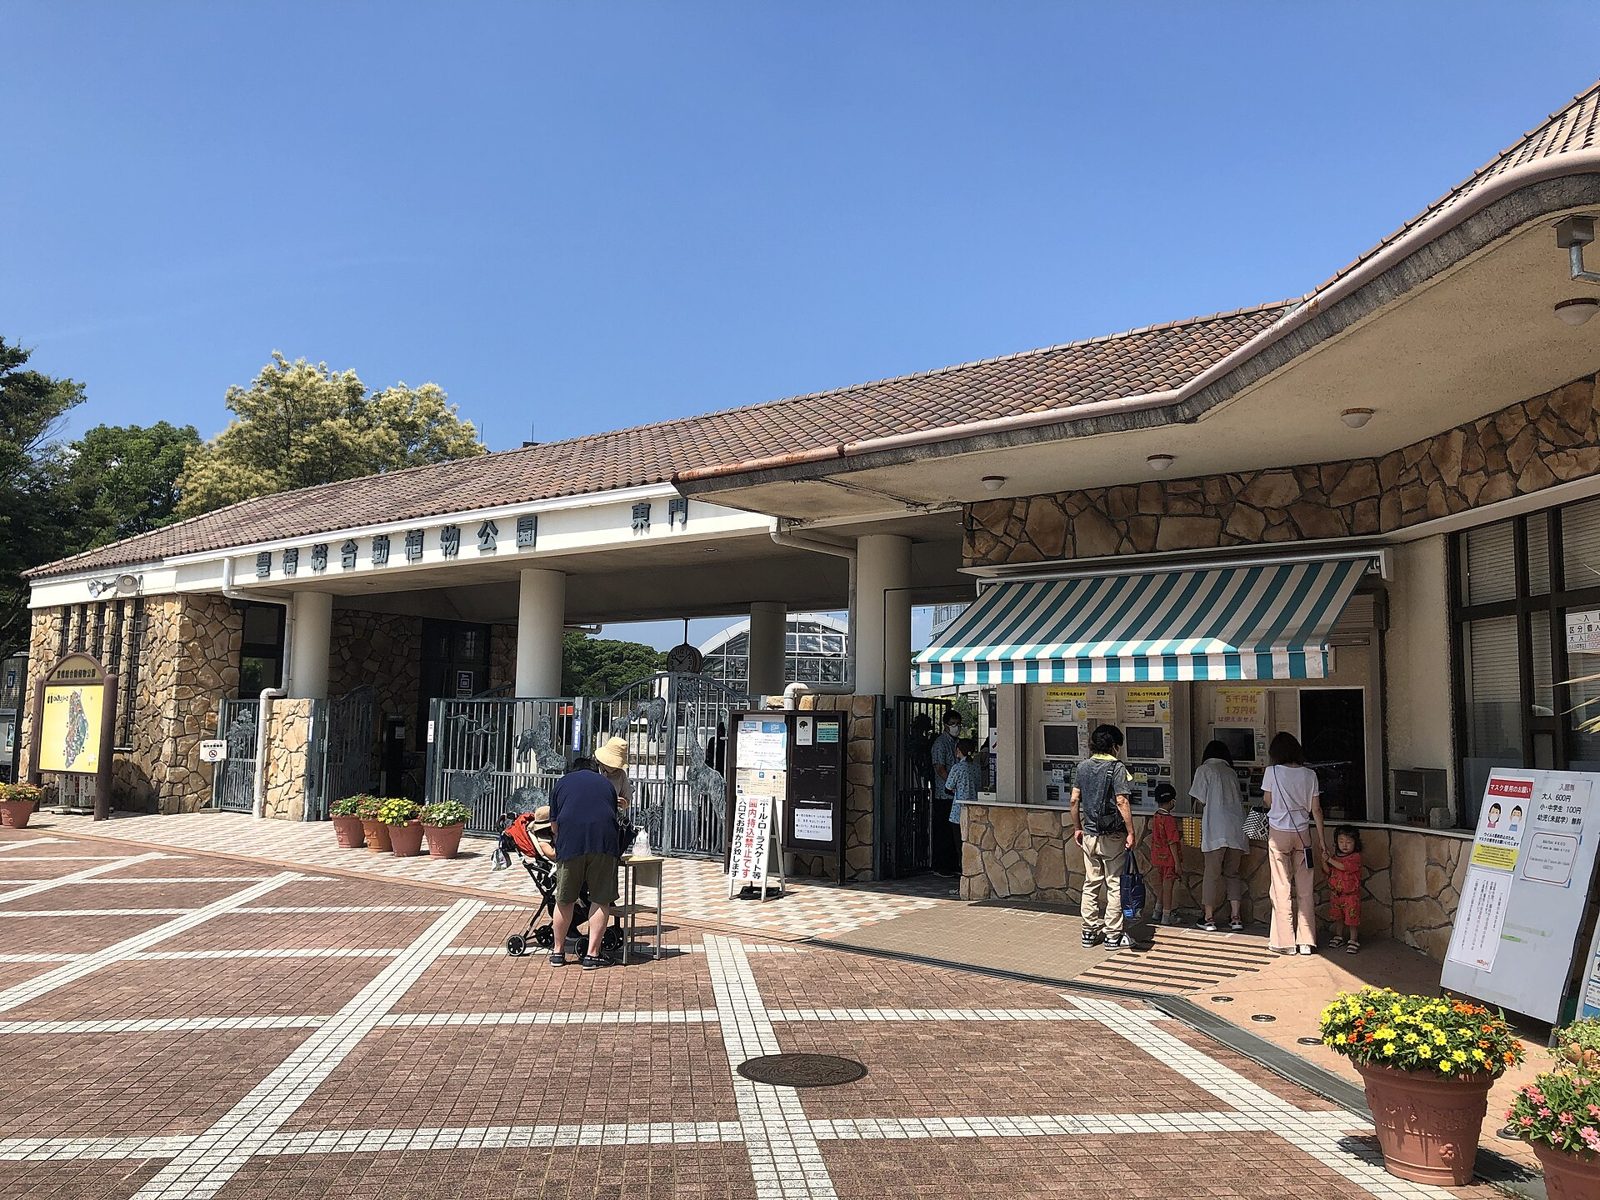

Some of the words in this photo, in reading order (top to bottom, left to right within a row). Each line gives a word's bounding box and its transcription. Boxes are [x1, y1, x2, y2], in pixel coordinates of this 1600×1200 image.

[631, 498, 688, 529] 東門
[256, 515, 538, 577] 豊橋総合動植物公園
[1225, 695, 1257, 703] 5千円札
[1540, 804, 1563, 812] 小・中学生
[1566, 806, 1582, 814] 100円
[1555, 794, 1571, 802] 600円
[731, 798, 747, 878] 入口でお預かり致します
[741, 798, 758, 879] 園内持込禁止です
